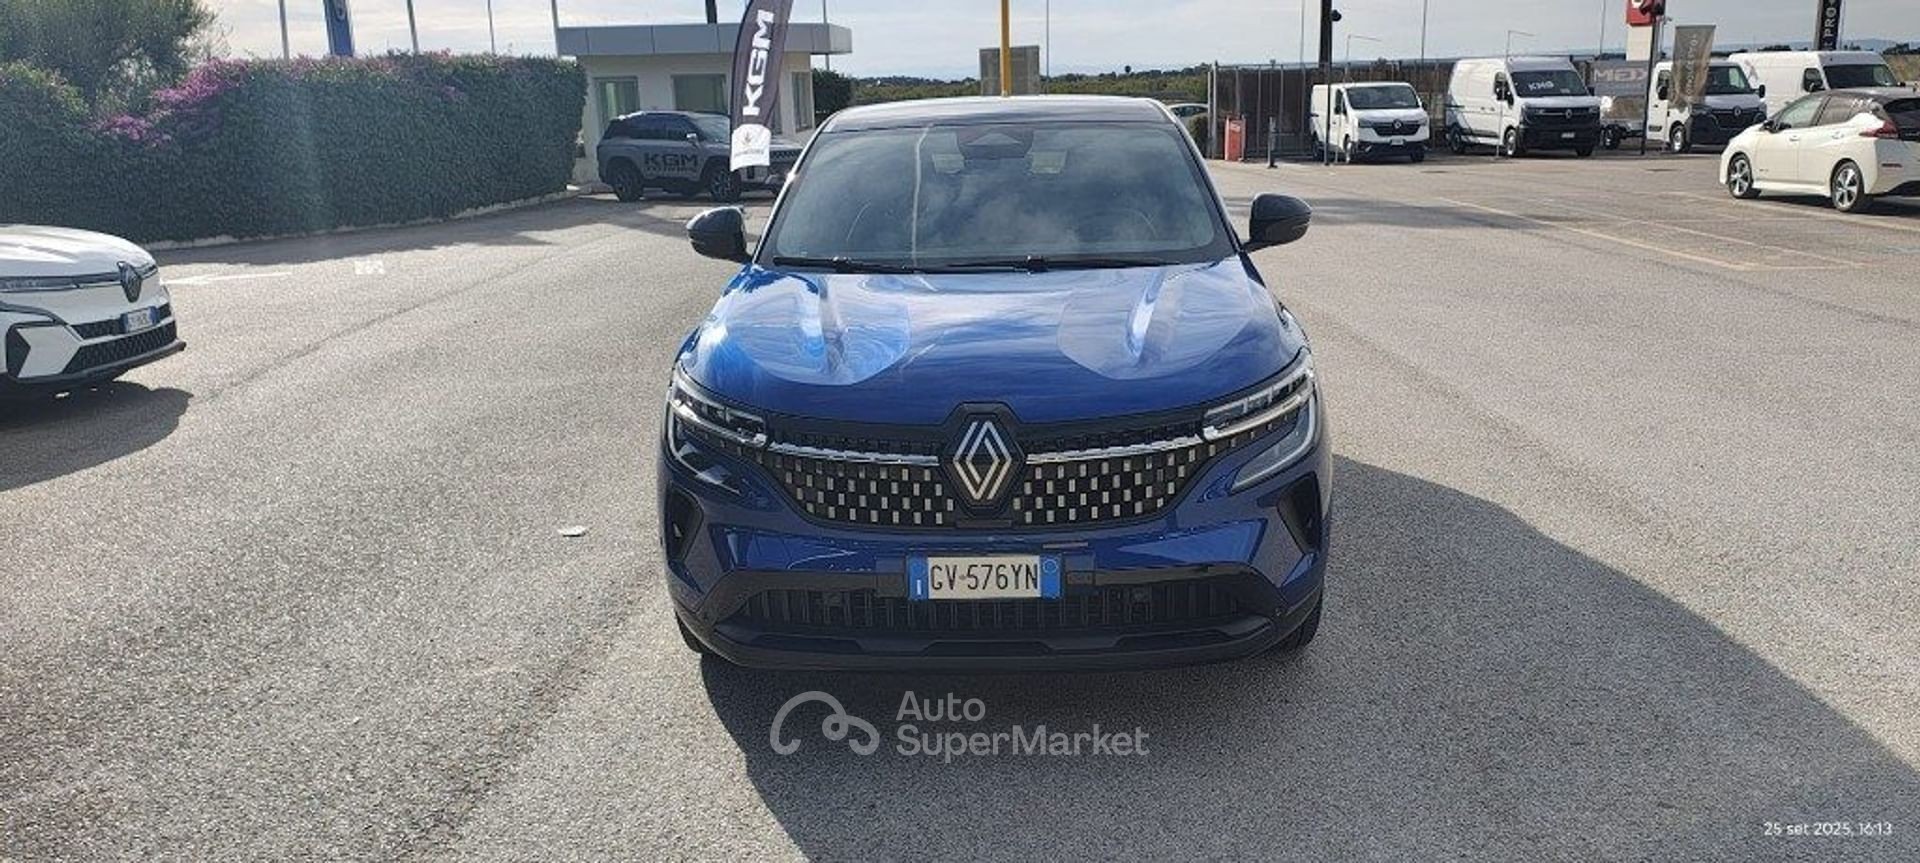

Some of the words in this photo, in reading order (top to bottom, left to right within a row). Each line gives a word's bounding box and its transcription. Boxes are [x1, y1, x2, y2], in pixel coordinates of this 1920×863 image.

[742, 9, 775, 116] KGM
[643, 153, 698, 167] KGM
[966, 564, 1039, 591] 576YN
